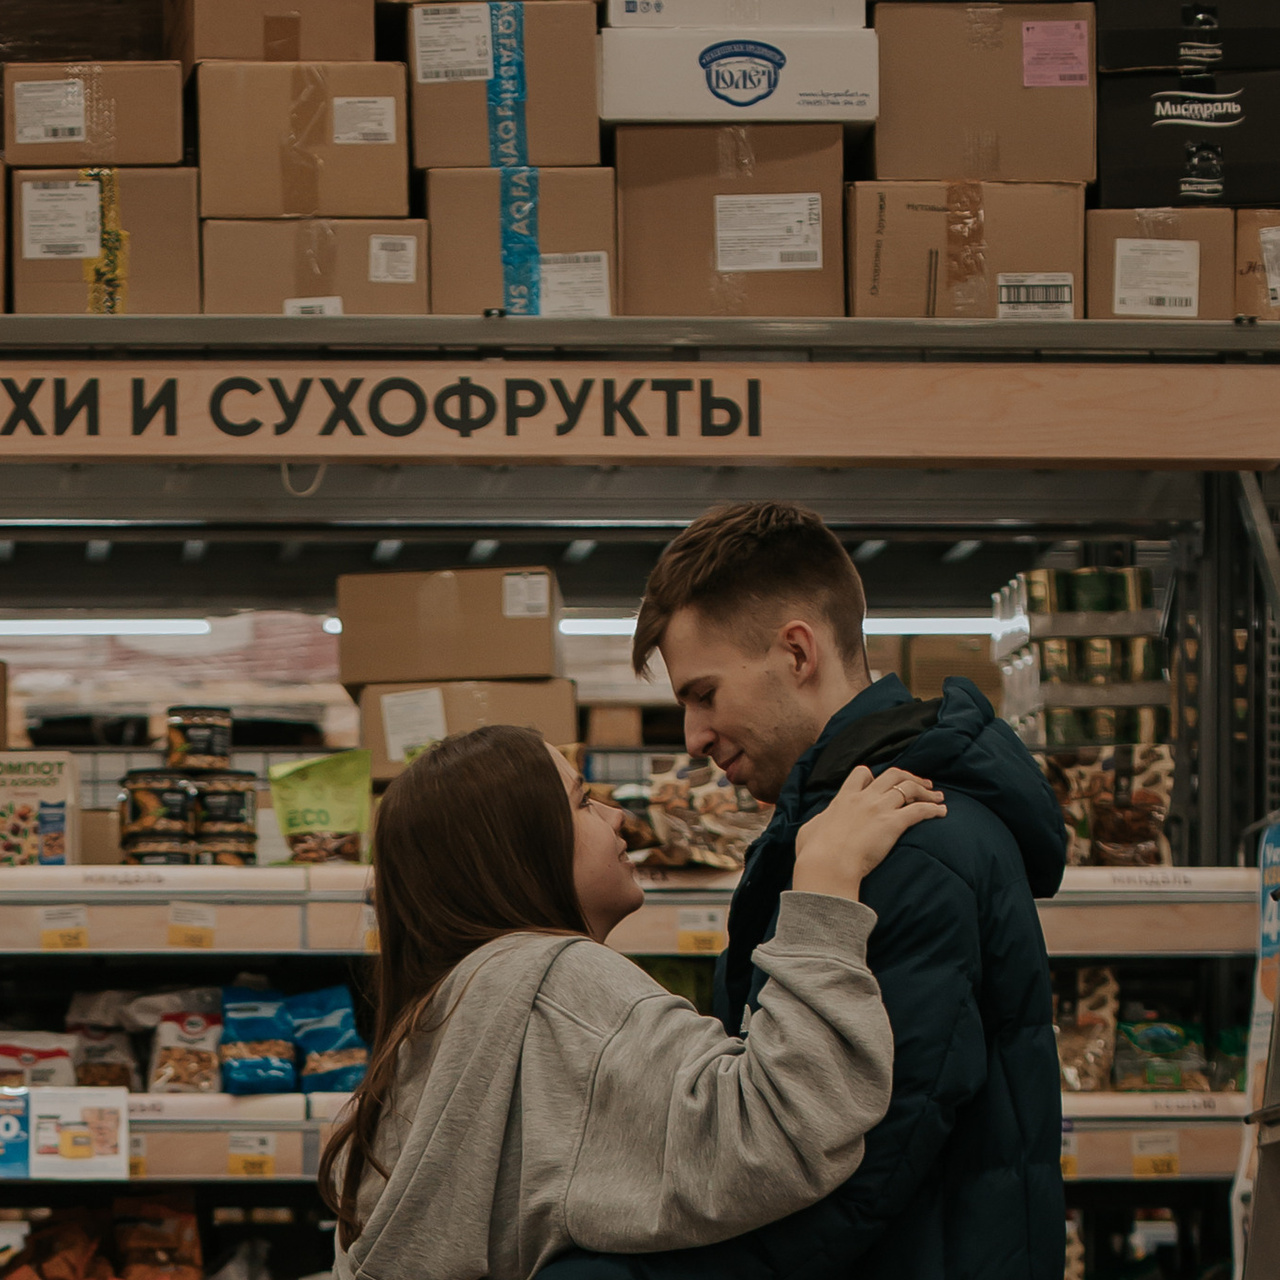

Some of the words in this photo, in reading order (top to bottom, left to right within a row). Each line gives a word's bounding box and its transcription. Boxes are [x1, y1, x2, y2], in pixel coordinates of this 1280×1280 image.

[1155, 101, 1241, 119] Мистраль
[132, 378, 177, 436] И
[210, 376, 761, 438] СУХОФРУКТЫ
[287, 808, 330, 828] ECO
